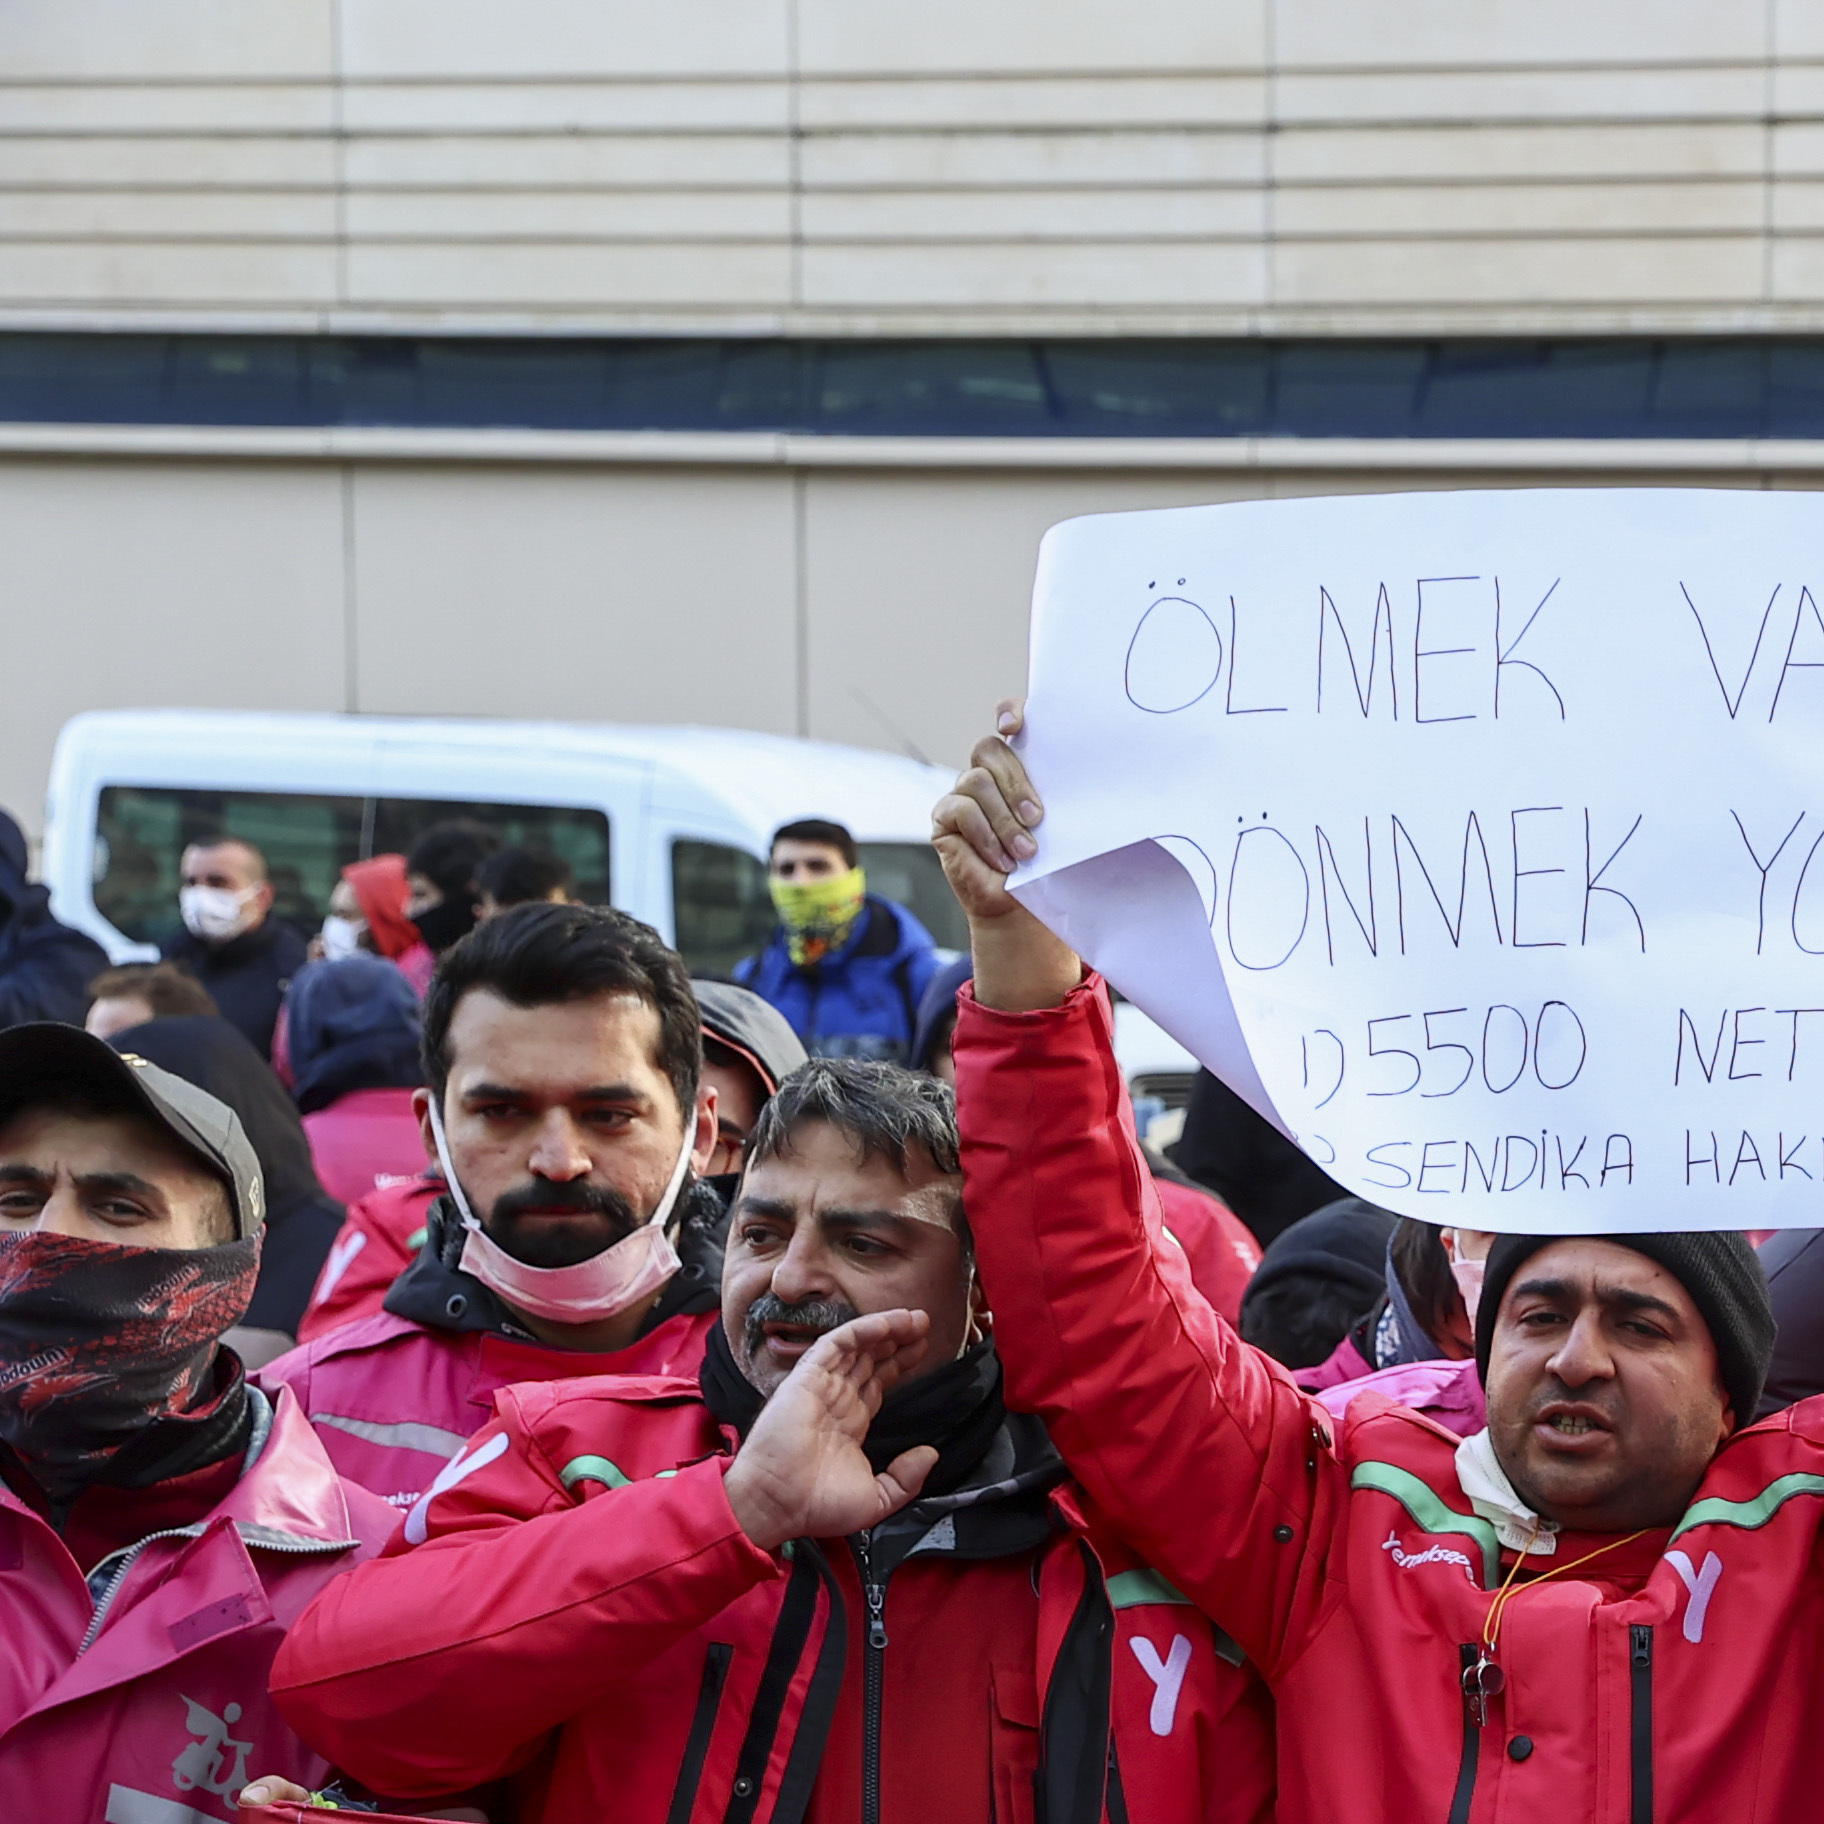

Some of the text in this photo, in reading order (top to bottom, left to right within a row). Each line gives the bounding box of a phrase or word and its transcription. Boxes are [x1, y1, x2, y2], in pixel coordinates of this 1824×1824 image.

[1124, 576, 1566, 723] ÖLMEK
[1366, 1001, 1587, 1098] 5500
[1362, 1128, 1634, 1195] SENDİKA
